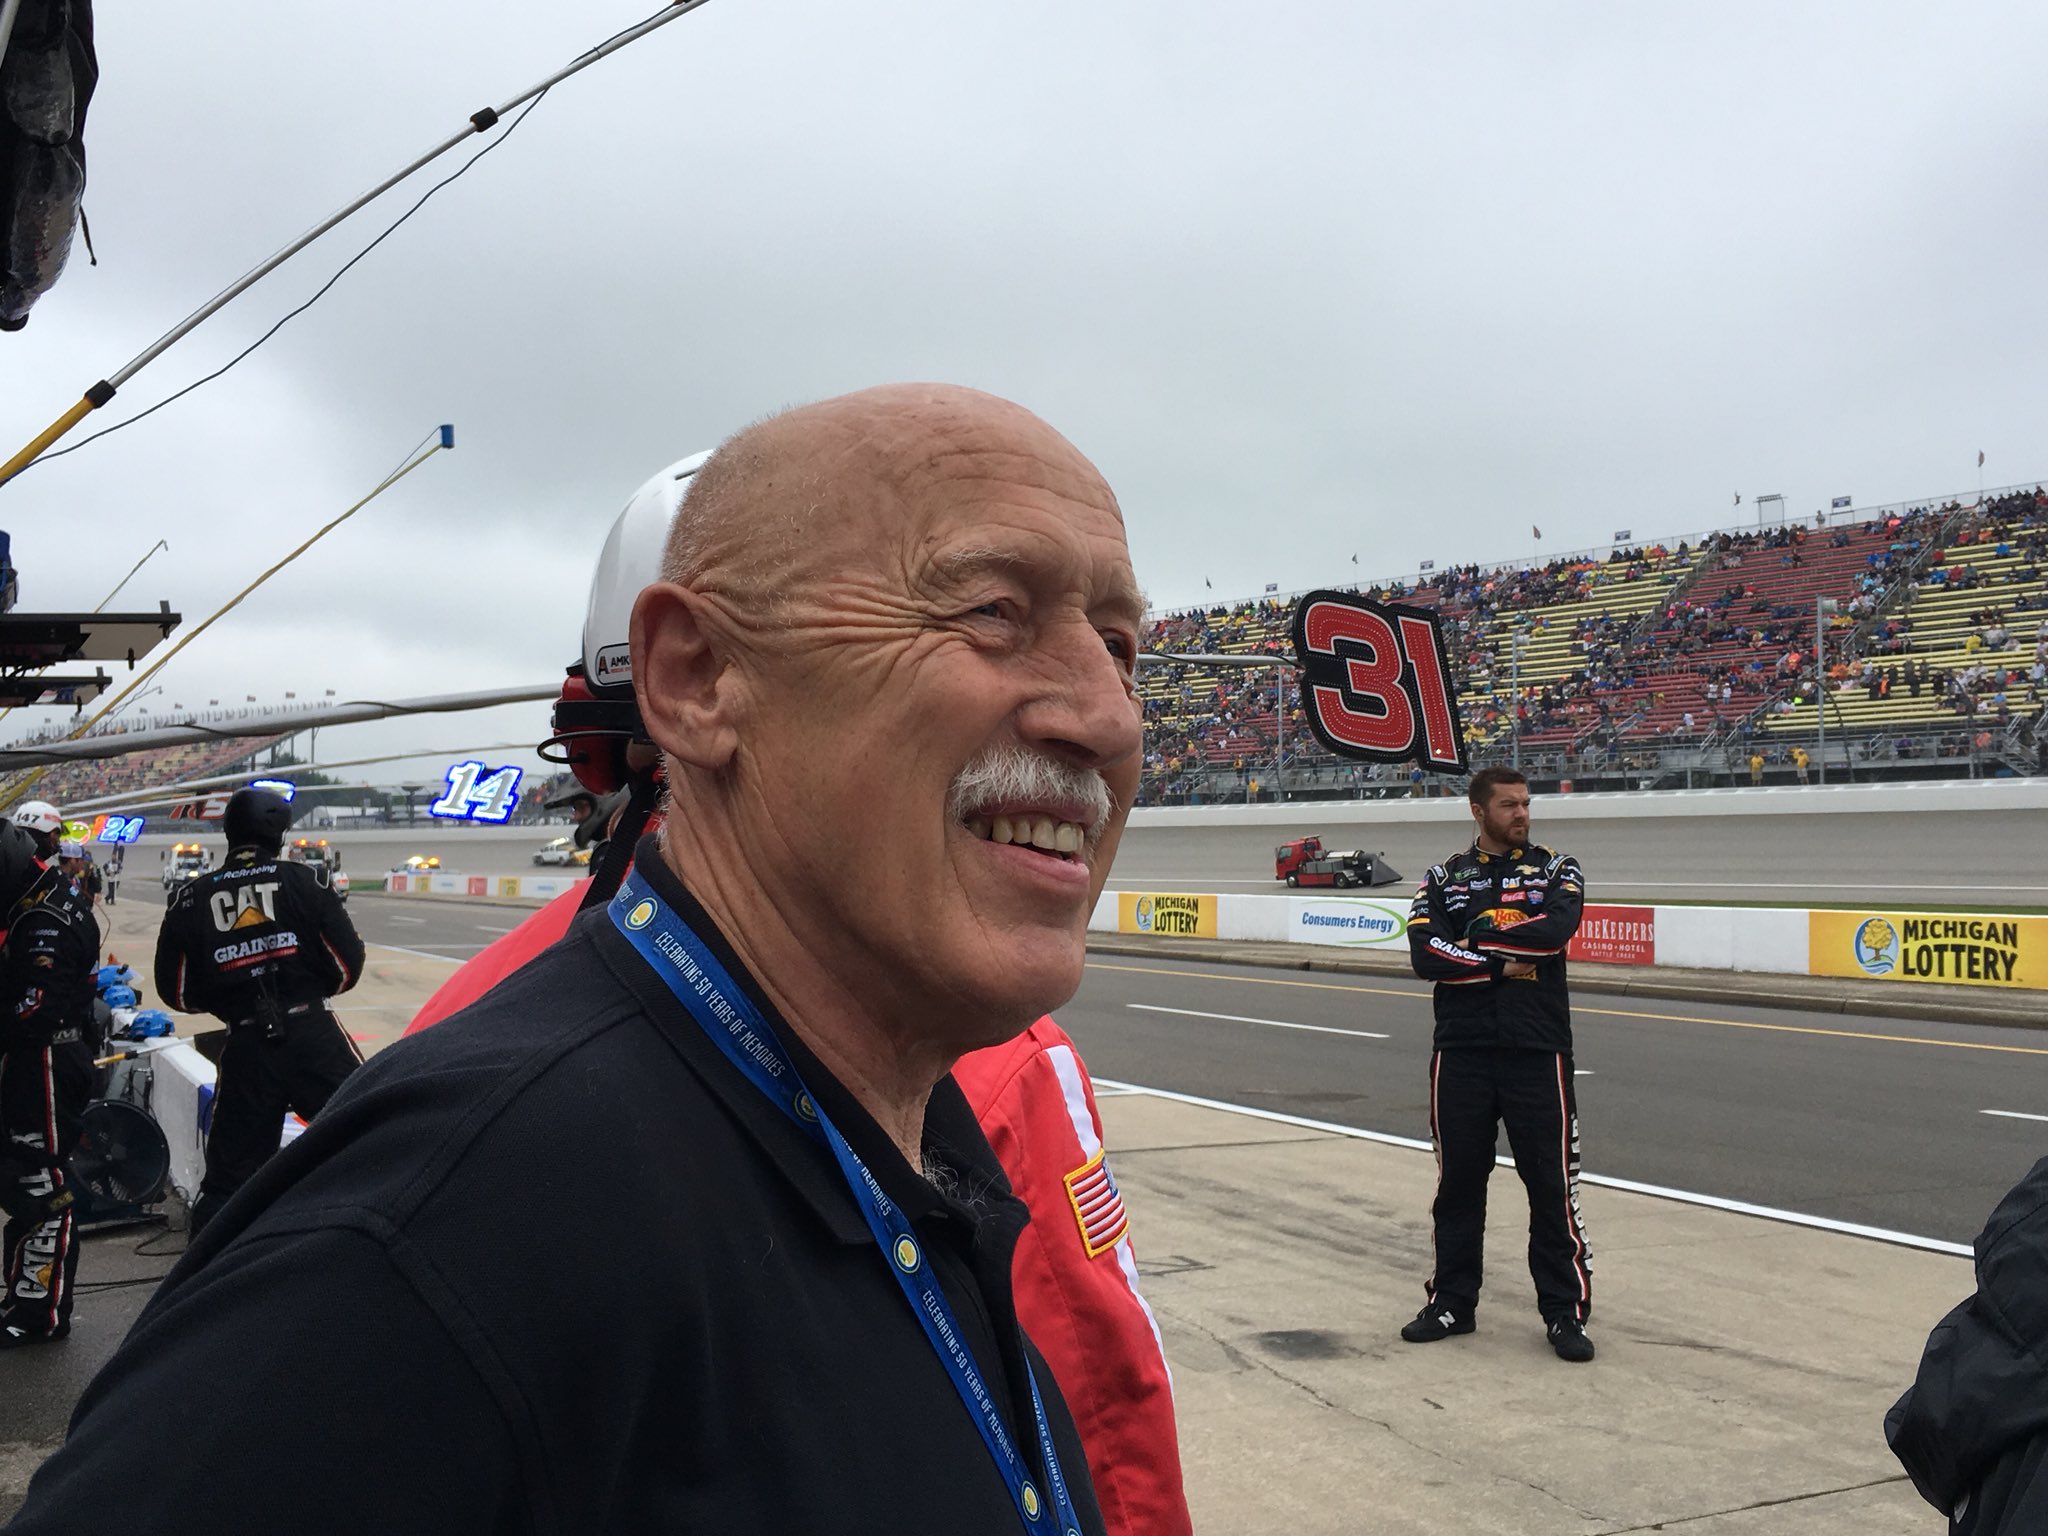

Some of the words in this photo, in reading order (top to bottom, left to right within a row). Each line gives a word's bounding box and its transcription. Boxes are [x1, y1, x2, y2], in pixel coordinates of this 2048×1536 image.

[1301, 596, 1460, 767] 31
[430, 761, 523, 824] 14
[98, 815, 145, 843] 24
[1502, 876, 1521, 889] CAT
[210, 882, 281, 933] CAT
[1154, 896, 1199, 914] MICHIGAN
[1154, 911, 1198, 933] LOTTERY
[1302, 912, 1356, 928] Consumers
[1358, 915, 1393, 932] Energy
[1903, 919, 2018, 949] MICHIGAN
[214, 931, 299, 964] GRAINGER
[1582, 942, 1613, 951] CASINO
[1618, 943, 1645, 953] HOTEL
[1903, 944, 2018, 982] LOTTERY
[655, 931, 703, 983] CELEBRATING
[695, 976, 712, 996] 50
[705, 991, 736, 1024] YEARS
[728, 1018, 748, 1035] OF
[739, 1031, 786, 1077] MEMORIES
[922, 1289, 960, 1355] CELEBRATING
[955, 1351, 967, 1369] 50
[963, 1366, 985, 1399] YEARS
[981, 1398, 992, 1414] OF
[987, 1413, 1016, 1465] MEMORIES
[1039, 1424, 1048, 1437] 50
[1043, 1440, 1066, 1506] CELEBRATING
